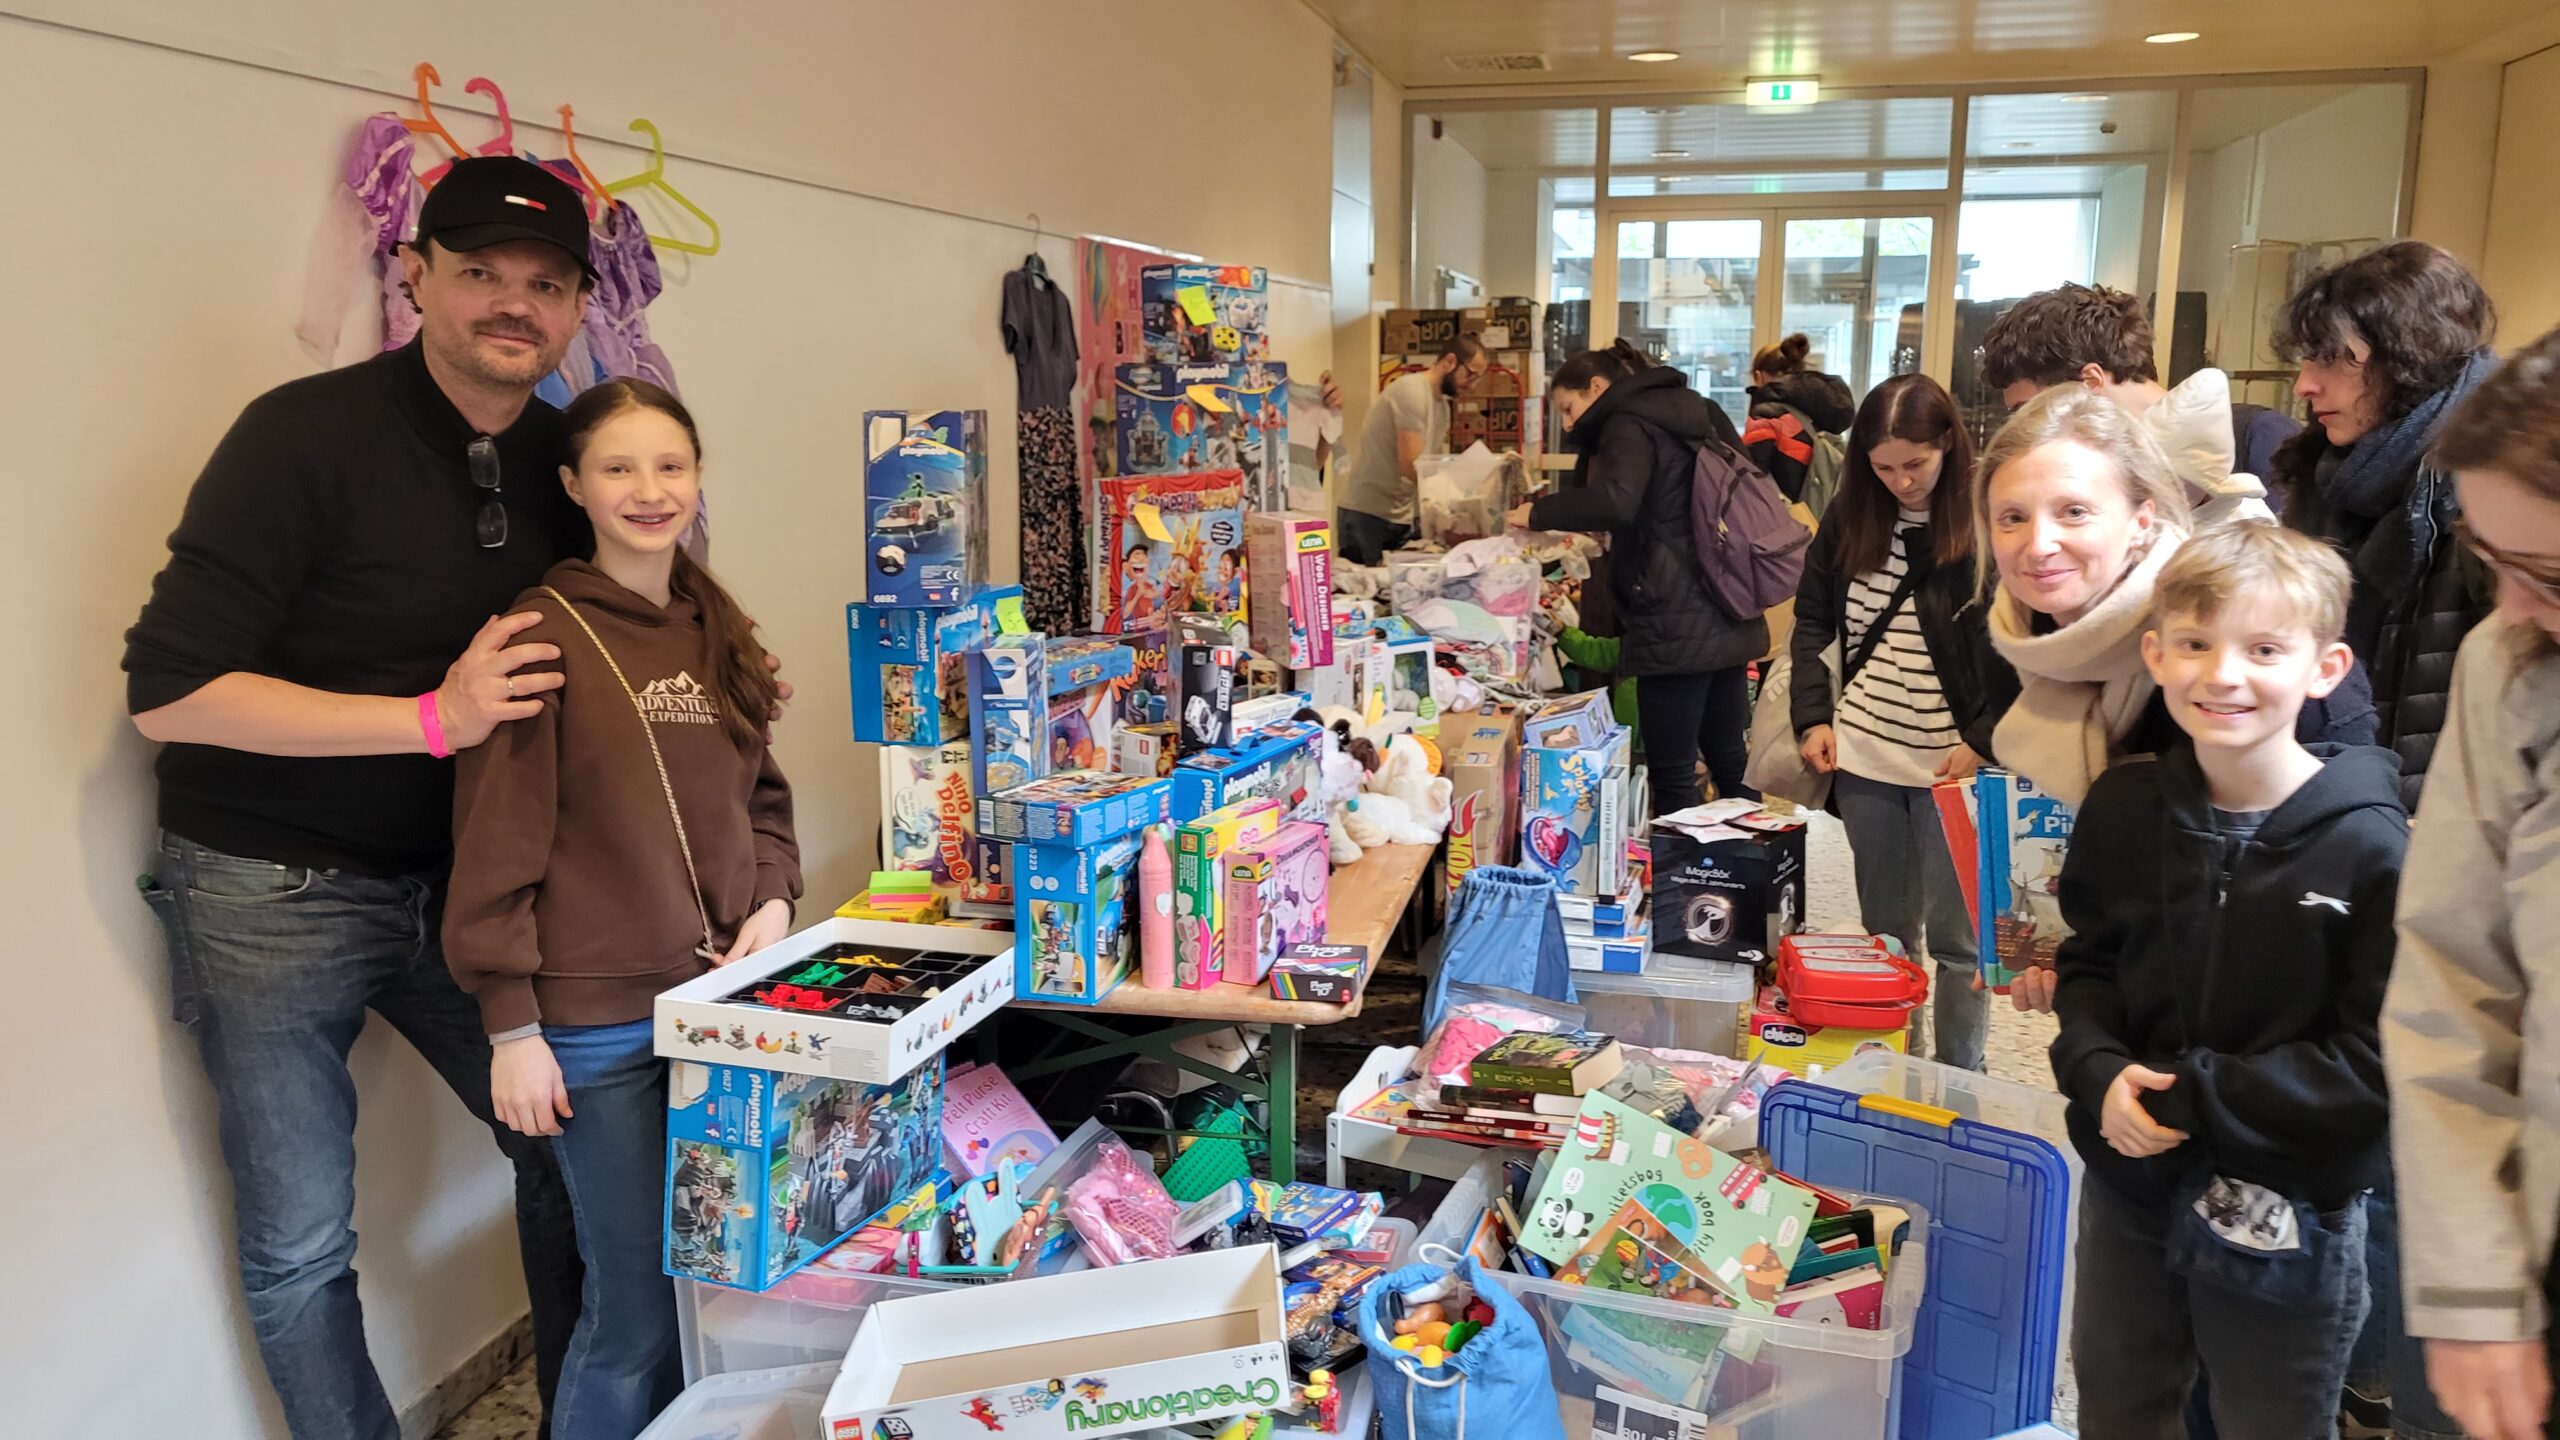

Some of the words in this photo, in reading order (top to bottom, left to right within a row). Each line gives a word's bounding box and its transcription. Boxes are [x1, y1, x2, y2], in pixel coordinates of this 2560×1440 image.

[916, 610, 930, 662] playmobil
[638, 696, 719, 714] ADVENTUR
[649, 711, 714, 725] EXPEDITION
[944, 770, 972, 815] Nino
[936, 787, 973, 881] Delfino
[1077, 852, 1089, 895] playmobil
[1295, 944, 1352, 954] Phase
[1309, 950, 1337, 958] 10
[1310, 980, 1333, 990] Phase
[1316, 987, 1331, 997] 10
[1763, 1026, 1804, 1044] chicco
[748, 1073, 765, 1148] playmobil
[943, 1101, 968, 1125] Felt
[962, 1076, 1000, 1106] Purse
[965, 1108, 997, 1135] Craft
[991, 1093, 1012, 1112] Kit
[1694, 1191, 1715, 1227] book
[1064, 1377, 1280, 1432] Creationary
